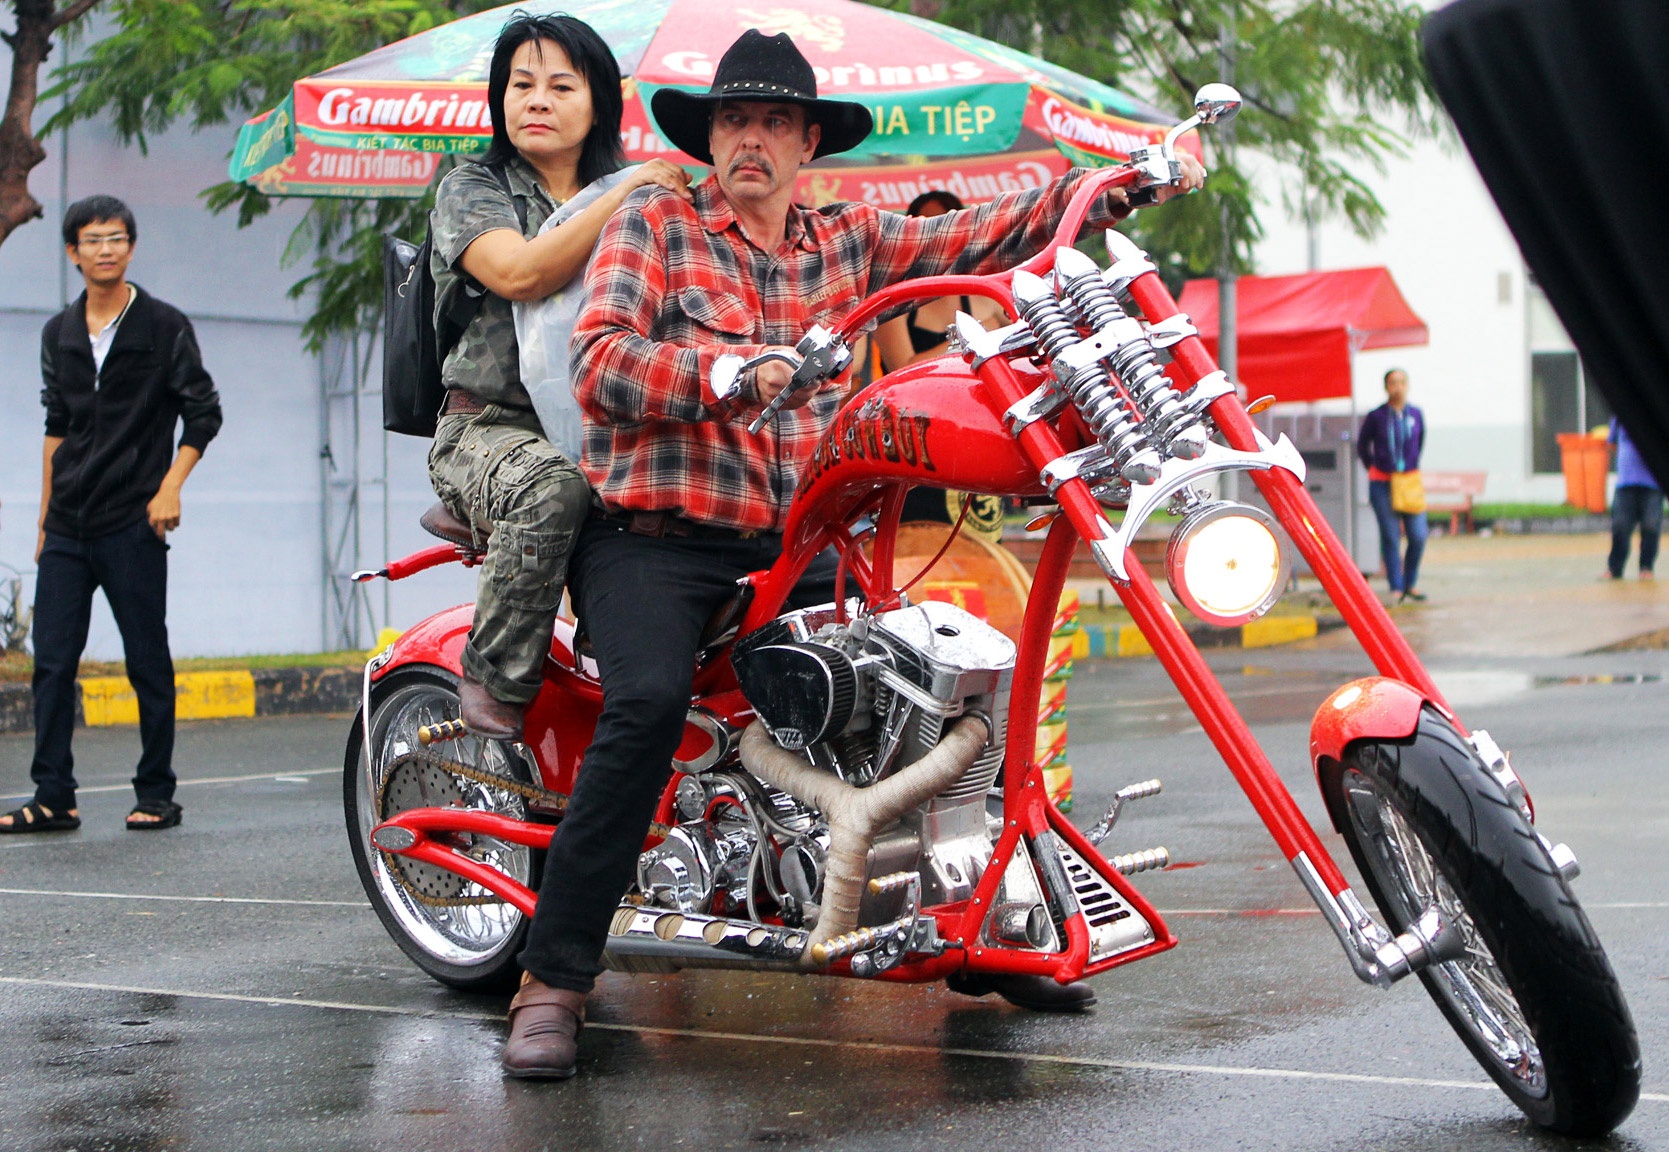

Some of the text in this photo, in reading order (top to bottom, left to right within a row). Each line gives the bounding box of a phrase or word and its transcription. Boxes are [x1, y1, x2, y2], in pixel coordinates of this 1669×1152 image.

[661, 50, 984, 86] Grinus
[317, 87, 493, 128] Gambrin
[868, 99, 998, 143] IA TIỆP
[422, 138, 446, 152] BIA
